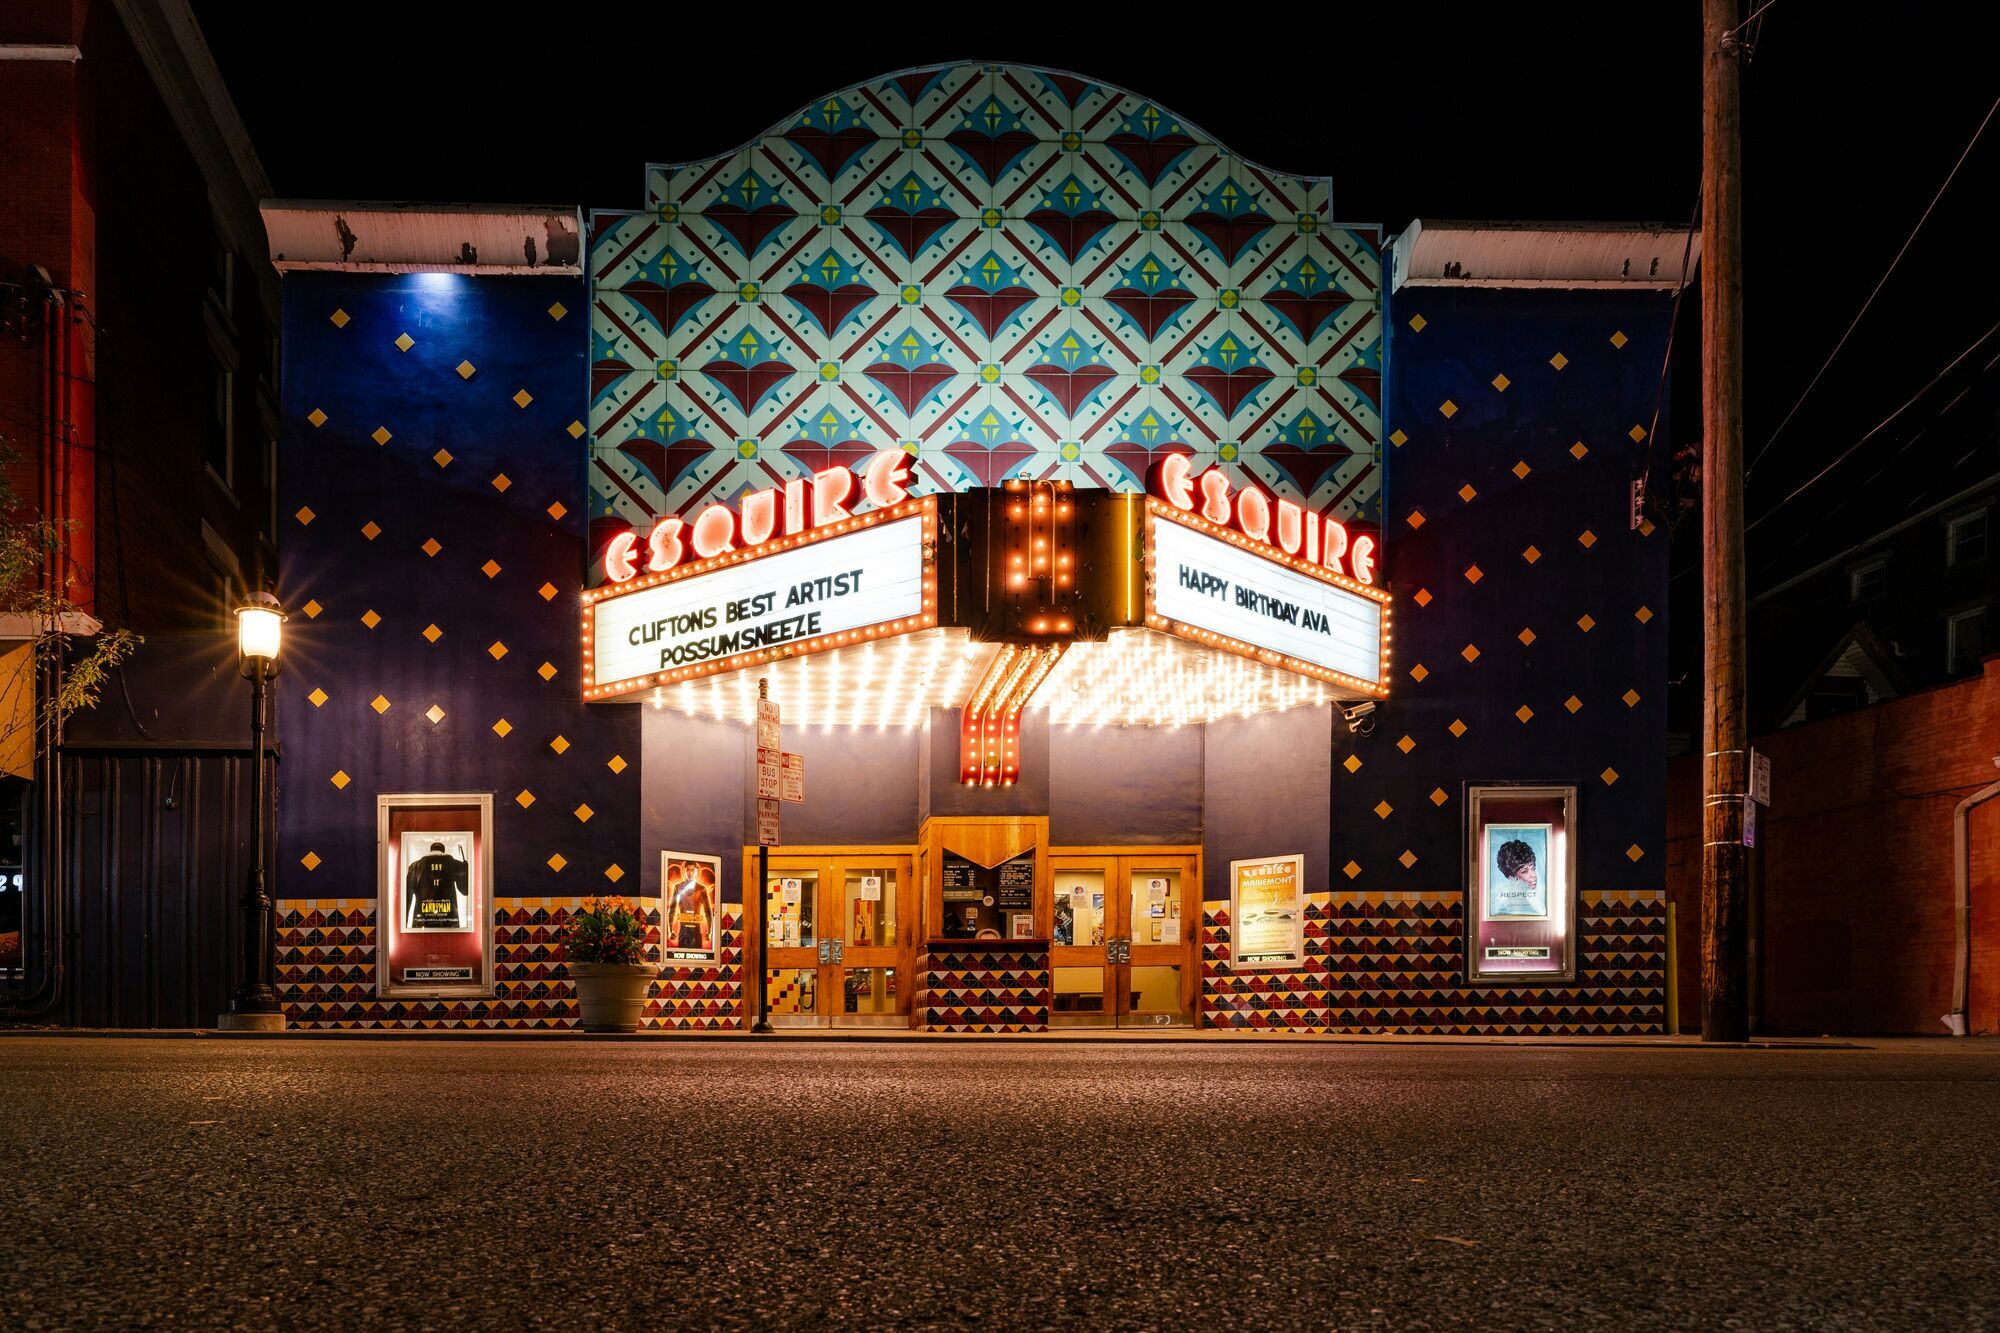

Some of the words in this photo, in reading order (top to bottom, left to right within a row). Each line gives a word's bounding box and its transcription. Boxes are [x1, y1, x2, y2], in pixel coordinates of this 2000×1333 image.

[604, 448, 909, 583] ESQUIRE
[1162, 453, 1375, 584] ESQUIRE
[1179, 563, 1229, 602] HAPPY
[1235, 584, 1300, 626] BIRTHDAY
[1301, 610, 1331, 636] AVA
[628, 606, 717, 647] CLIFTONS
[725, 590, 777, 624] BEST
[785, 568, 864, 609] ARTIST
[660, 610, 821, 669] POSSUMSNEEZE
[764, 702, 774, 714] NO
[759, 711, 778, 725] PARKING
[762, 766, 776, 778] BUS
[760, 777, 778, 790] STOP
[764, 801, 772, 810] NO
[758, 810, 778, 820] PARKING
[431, 863, 442, 871] SAY
[433, 879, 440, 887] IT
[421, 902, 451, 913] CANDYMAN
